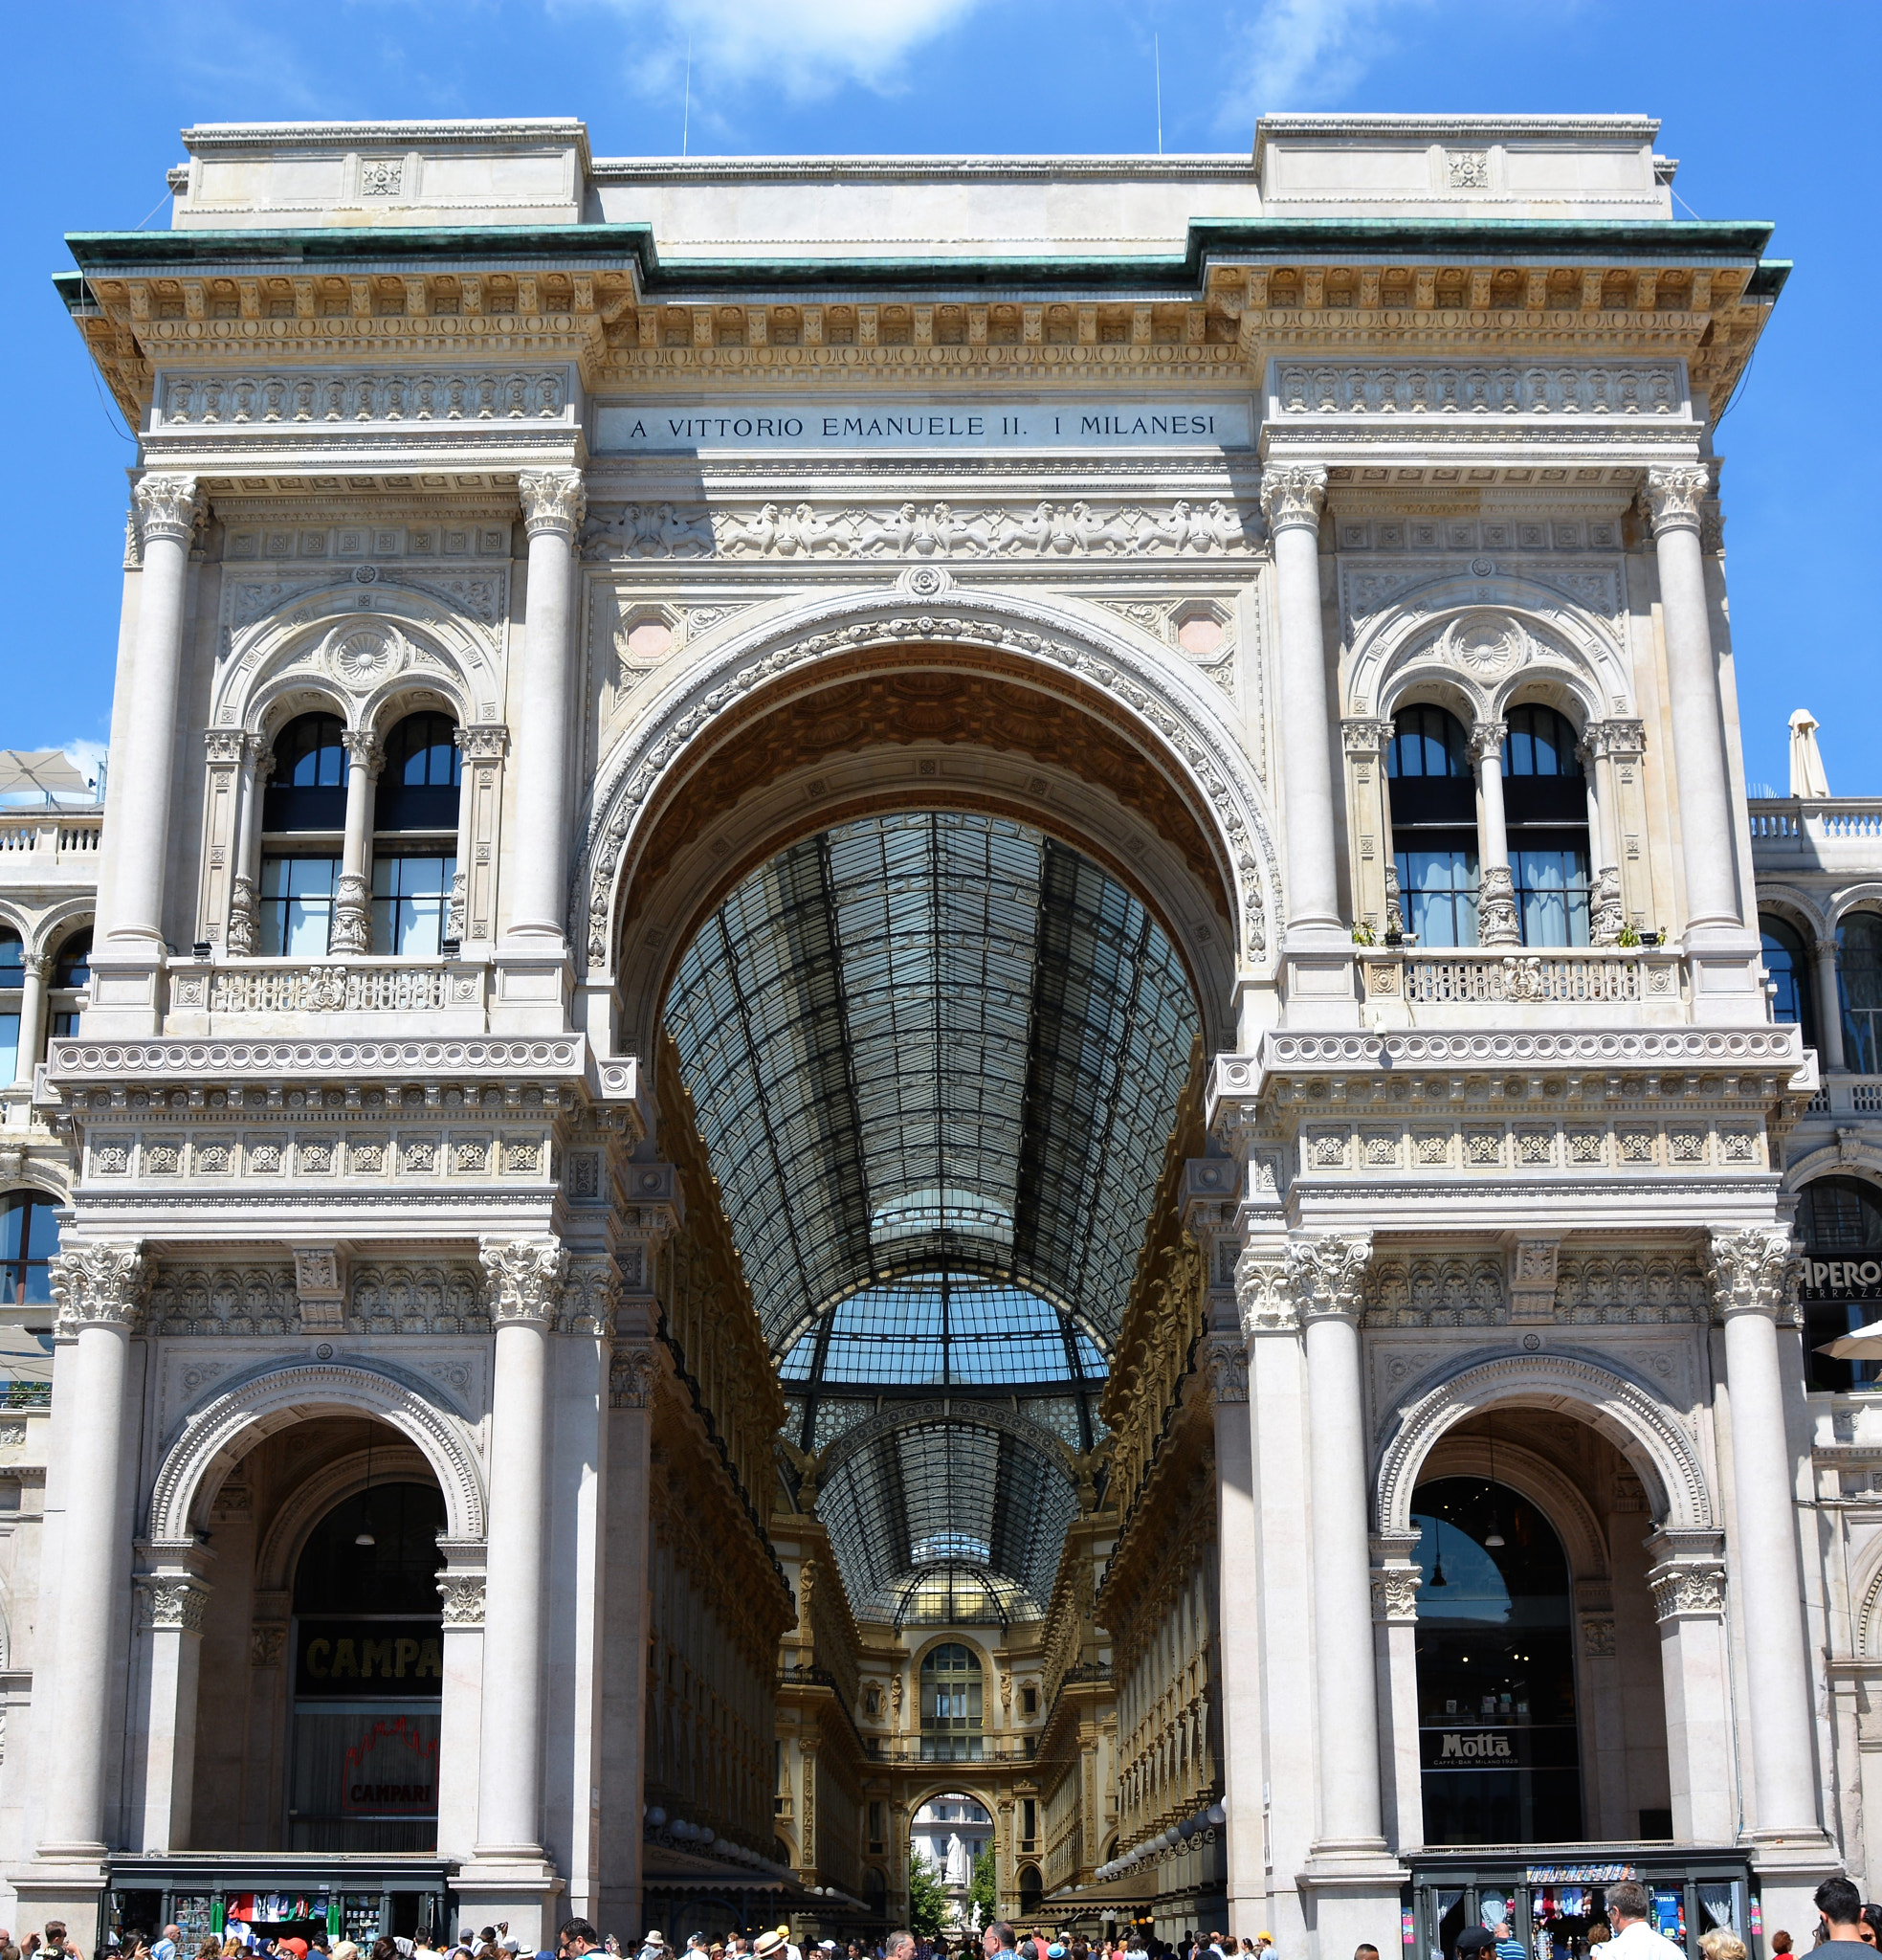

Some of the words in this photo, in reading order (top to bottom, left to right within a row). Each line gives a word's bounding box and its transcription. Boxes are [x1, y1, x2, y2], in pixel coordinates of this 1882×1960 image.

[631, 419, 648, 437] A
[668, 418, 803, 436] VITTORIO
[822, 416, 985, 436] EMANUELE
[1003, 416, 1027, 435] II.
[1054, 416, 1061, 434] I
[1080, 415, 1214, 434] MILANESI
[1799, 1257, 1882, 1288] APERO
[1805, 1287, 1882, 1299] ERRAZZ
[1441, 1733, 1512, 1757] Motta
[350, 1785, 432, 1803] CAMPARI
